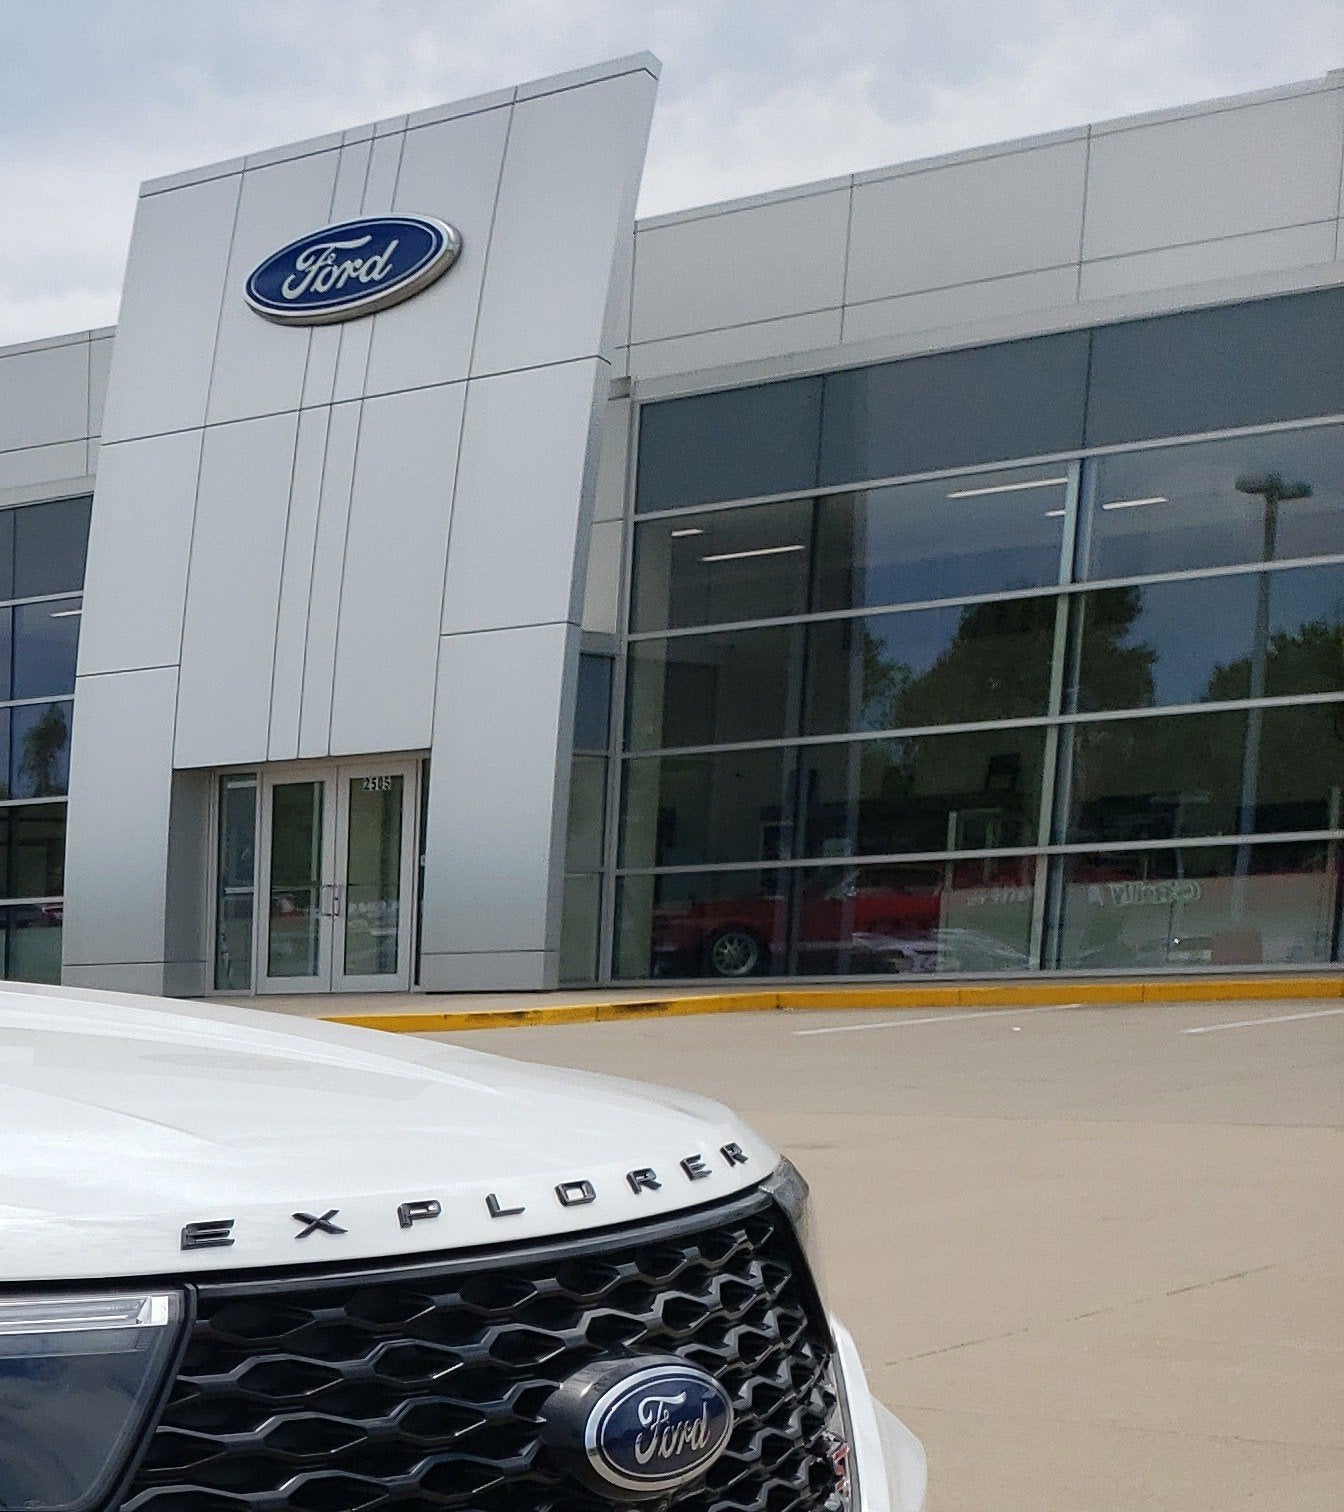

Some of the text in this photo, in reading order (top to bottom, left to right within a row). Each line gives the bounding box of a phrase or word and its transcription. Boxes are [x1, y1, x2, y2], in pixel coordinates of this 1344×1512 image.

[281, 235, 400, 299] Ford
[180, 1141, 750, 1251] EXPLORER
[633, 1390, 712, 1466] Ford
